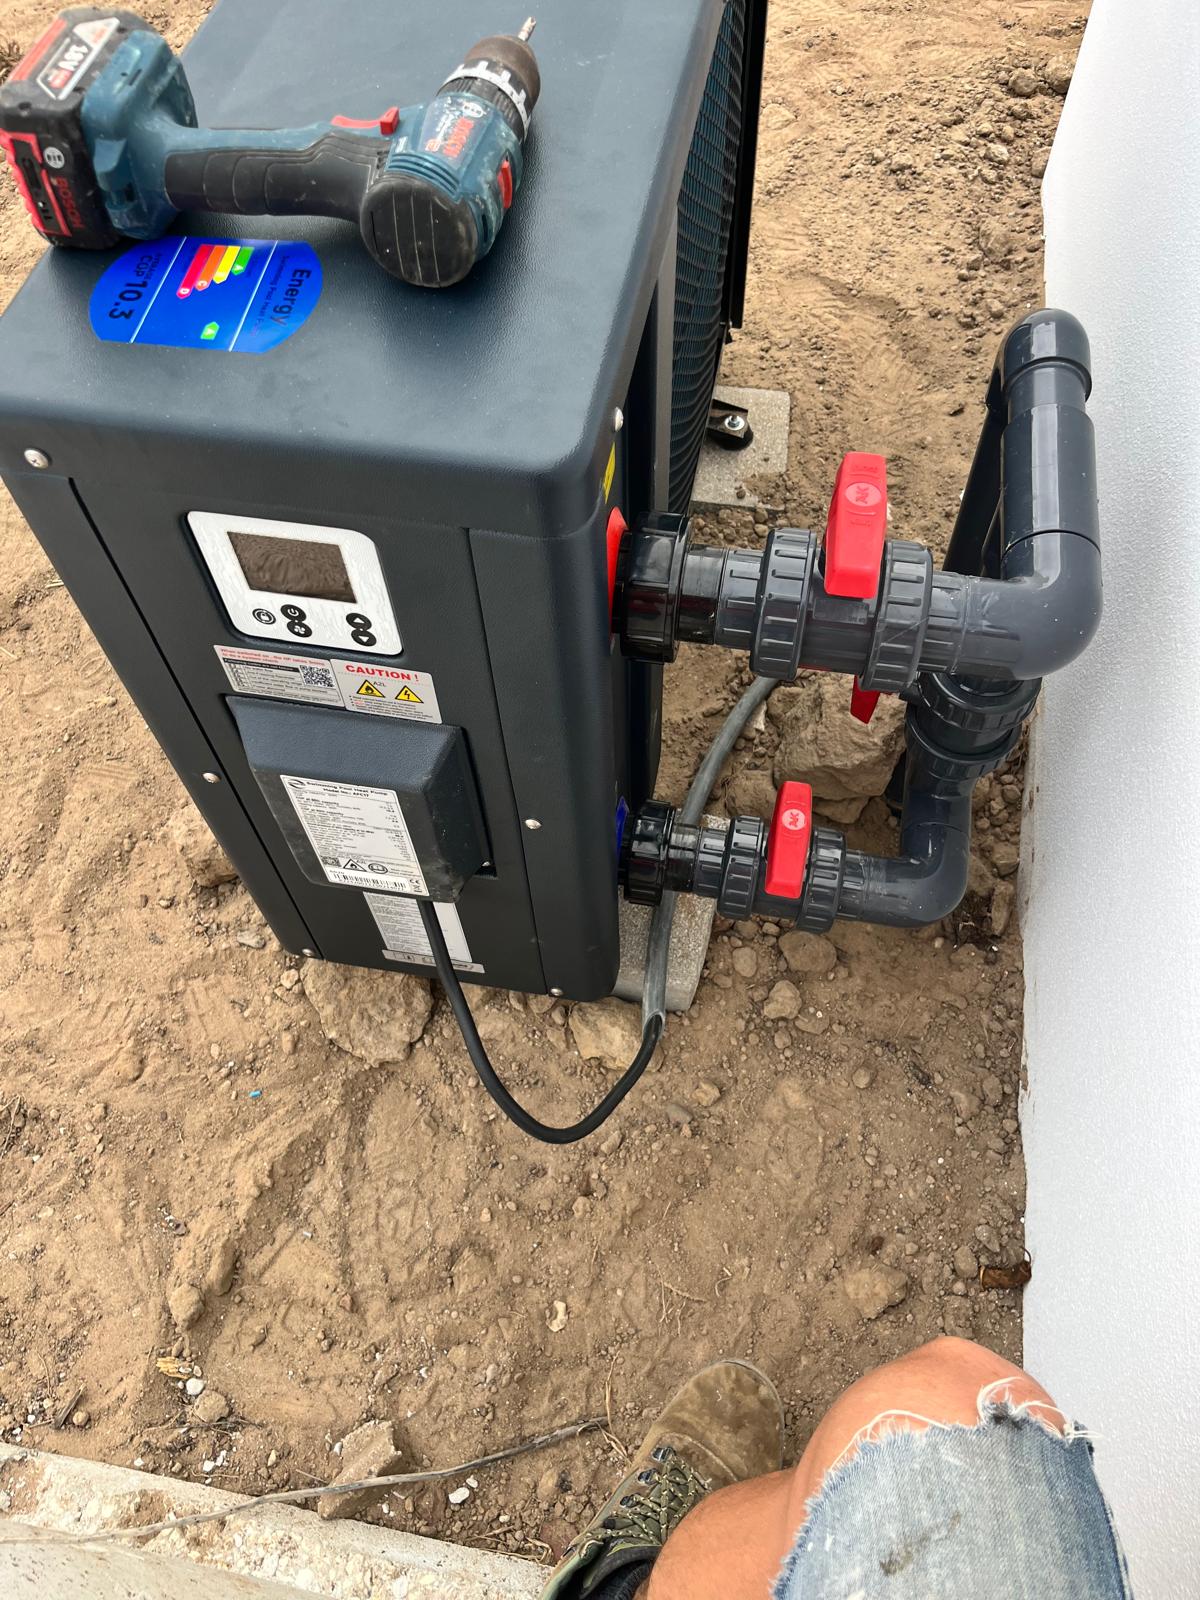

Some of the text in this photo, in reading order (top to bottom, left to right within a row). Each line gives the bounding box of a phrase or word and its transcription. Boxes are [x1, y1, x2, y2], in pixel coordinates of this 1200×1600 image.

[58, 44, 89, 72] 18V
[108, 255, 153, 319] COP 10.3
[270, 269, 312, 326] Energy
[345, 664, 411, 681] CAUTION
